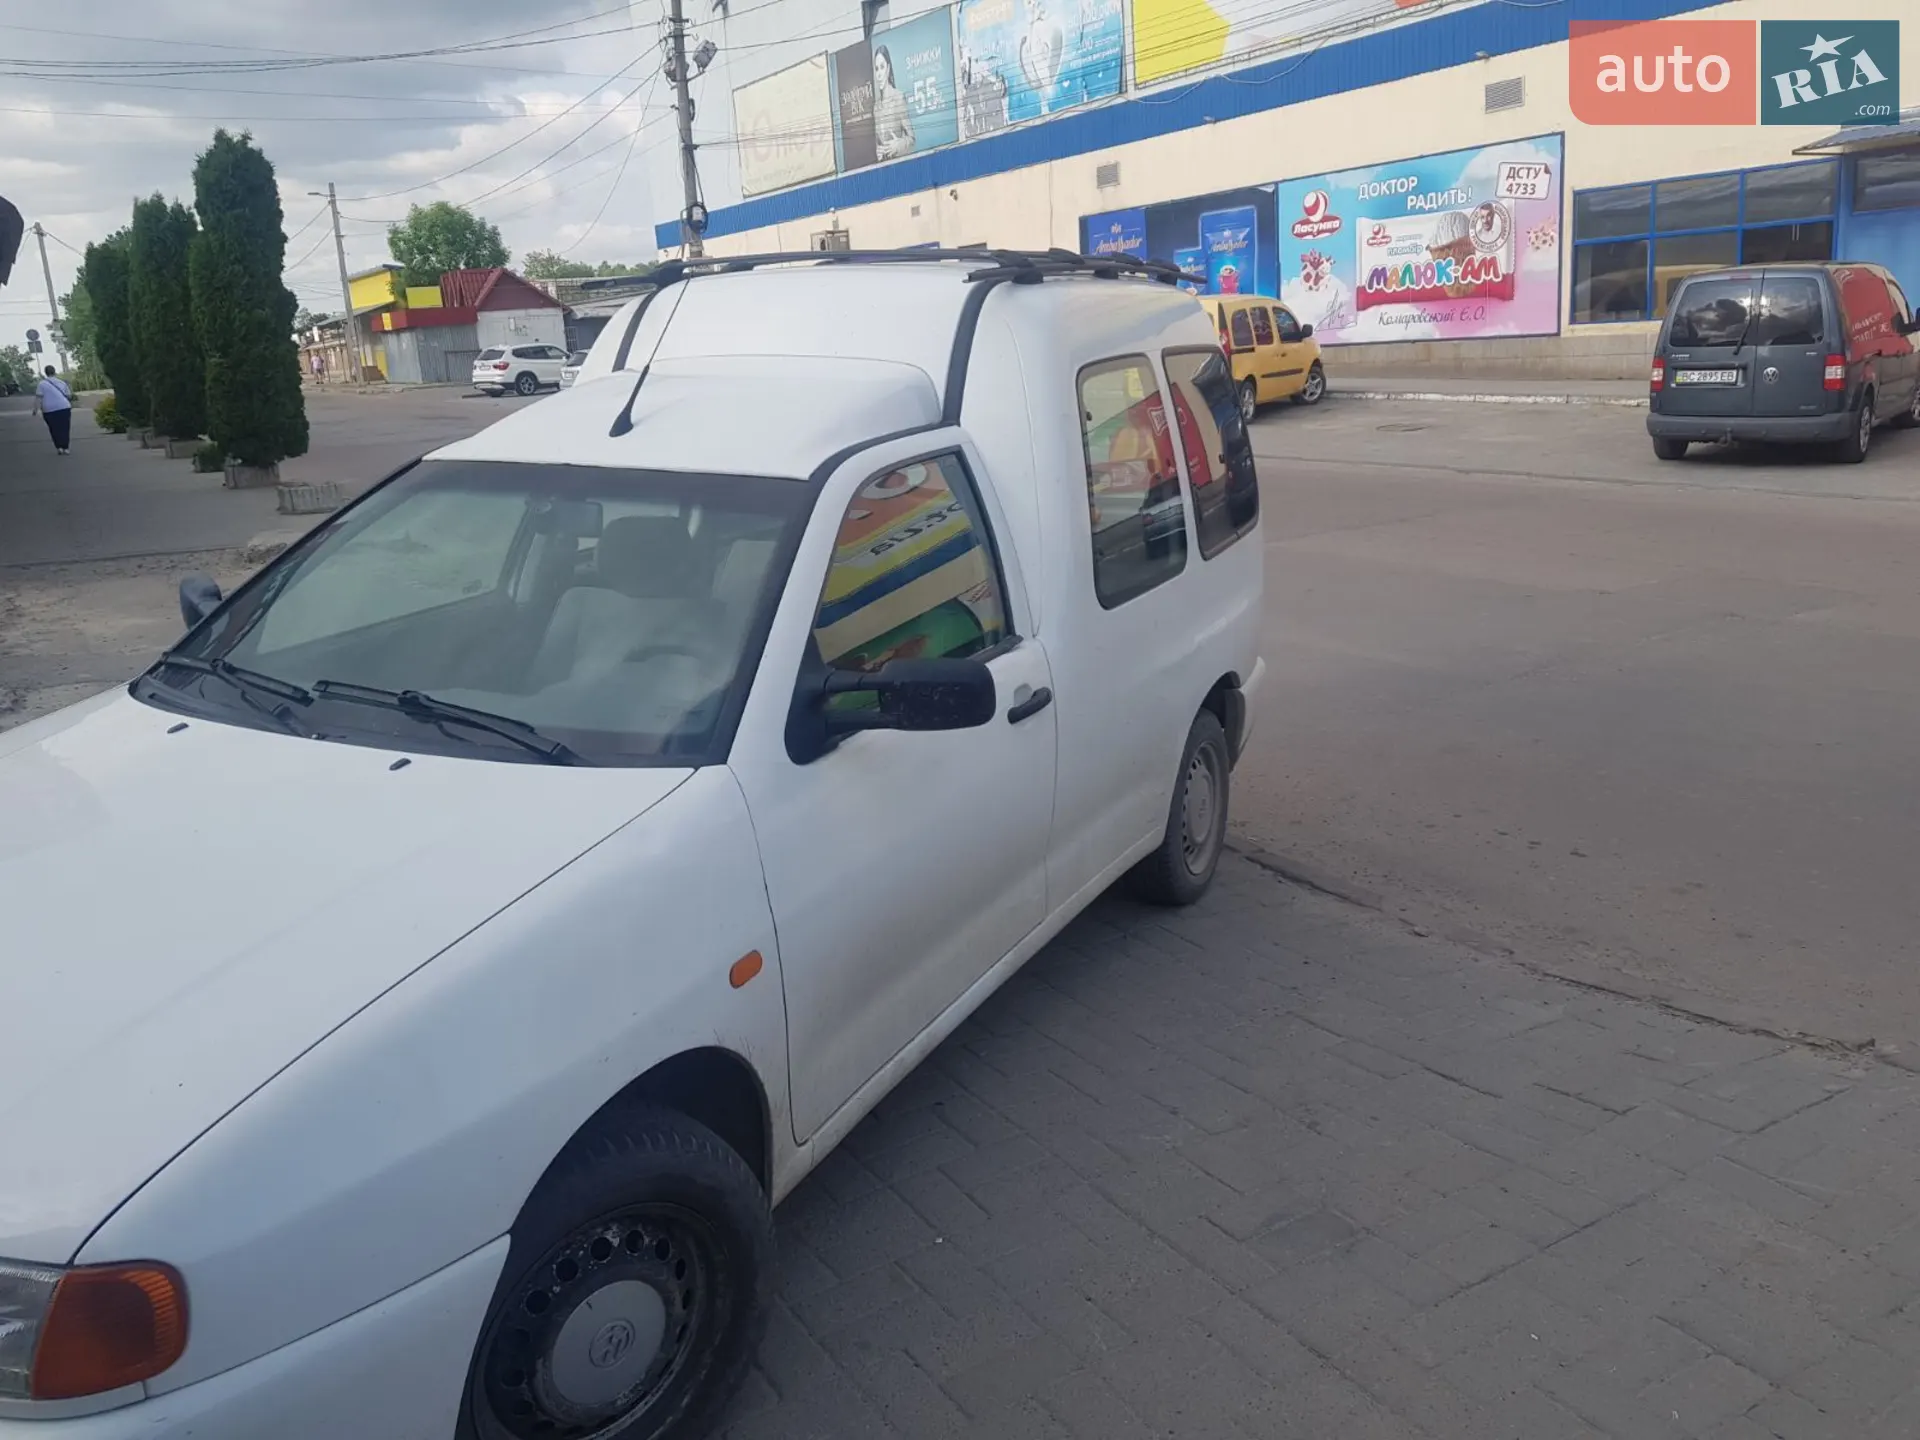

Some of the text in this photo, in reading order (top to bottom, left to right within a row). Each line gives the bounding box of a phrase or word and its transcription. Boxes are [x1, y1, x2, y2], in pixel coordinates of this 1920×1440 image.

[905, 45, 942, 70] ЗНИЖКИ
[1505, 166, 1542, 181] ДСТУ
[1358, 175, 1418, 201] ДОКТОР
[1407, 186, 1472, 211] РАДИТЬ!
[1505, 182, 1537, 196] 4733
